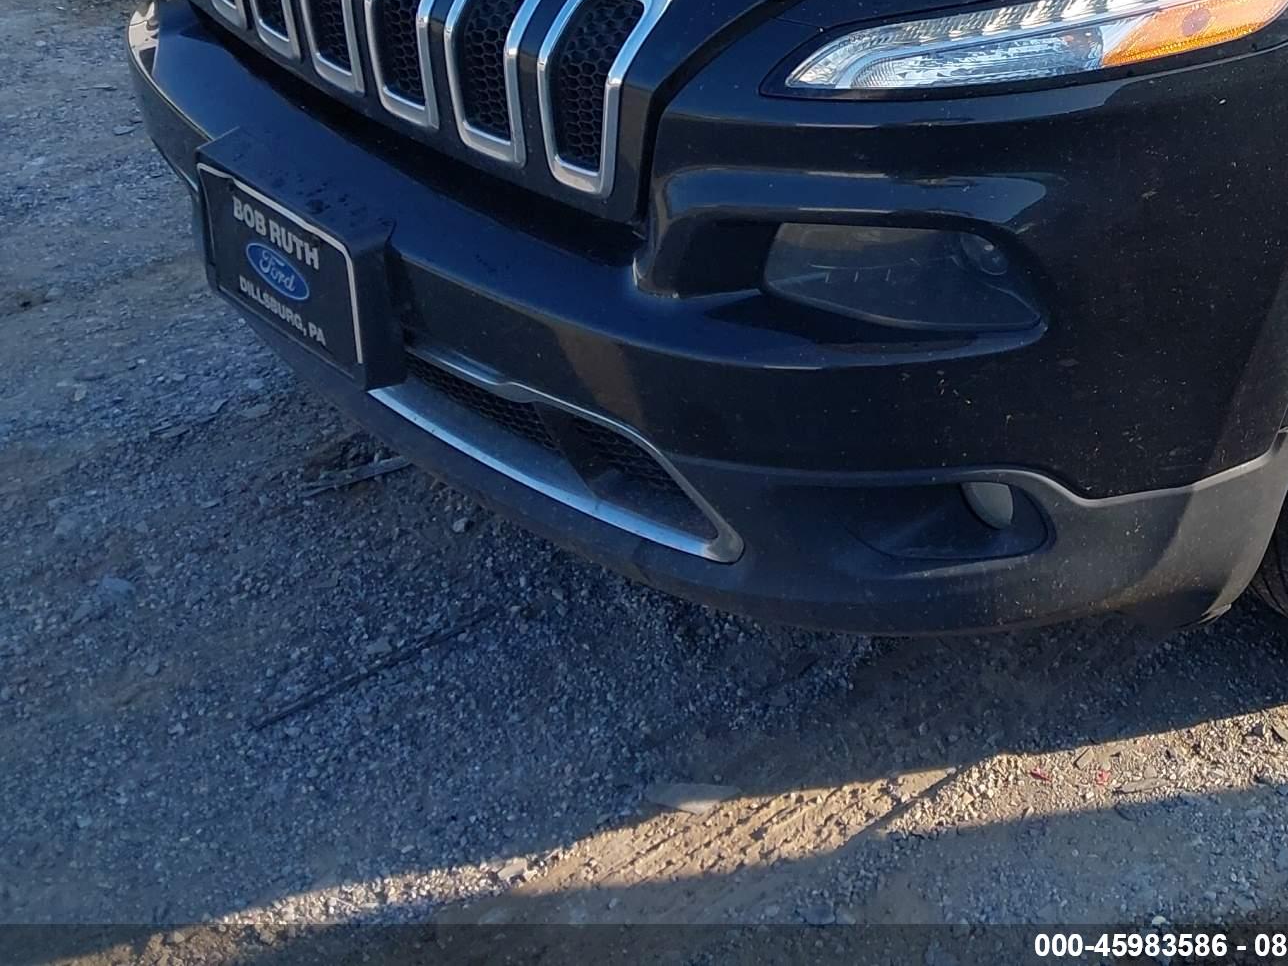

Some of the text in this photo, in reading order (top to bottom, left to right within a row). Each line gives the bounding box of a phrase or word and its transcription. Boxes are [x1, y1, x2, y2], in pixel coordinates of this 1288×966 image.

[232, 195, 319, 270] BOB RUTH
[258, 249, 296, 292] Ford
[239, 275, 327, 346] DILLSBURG, PA
